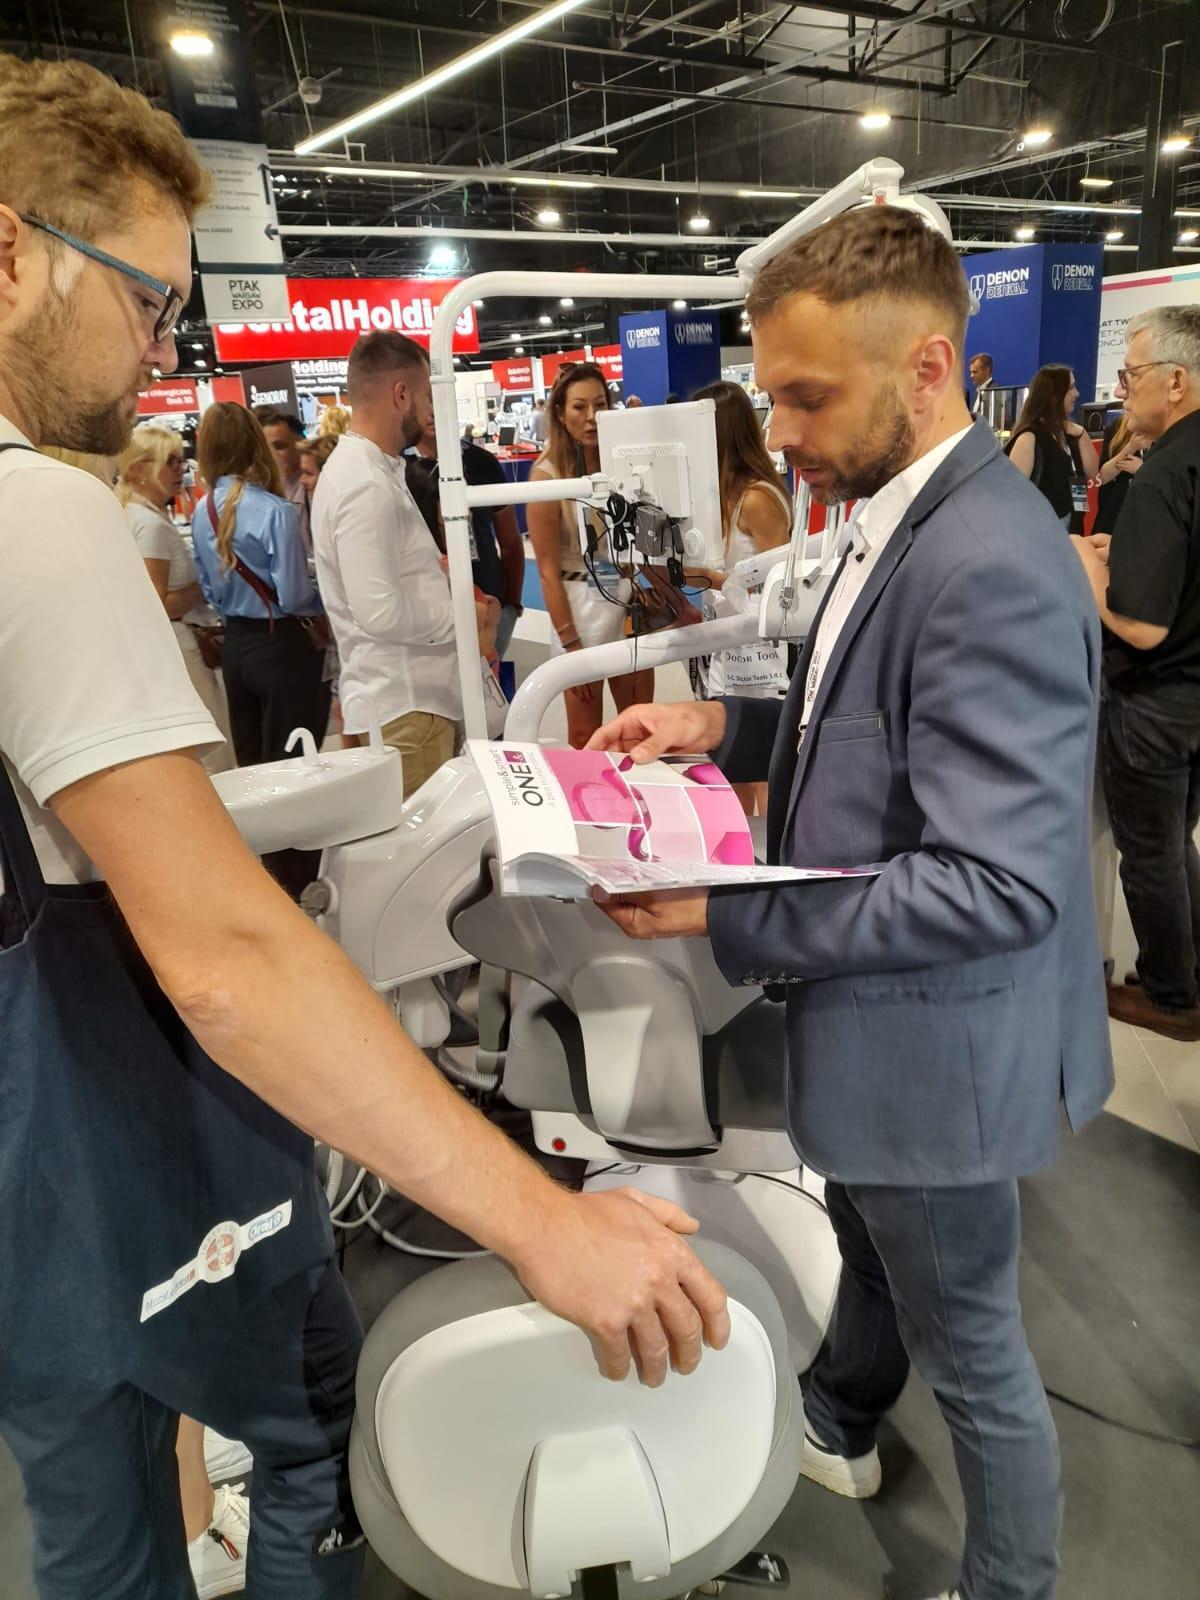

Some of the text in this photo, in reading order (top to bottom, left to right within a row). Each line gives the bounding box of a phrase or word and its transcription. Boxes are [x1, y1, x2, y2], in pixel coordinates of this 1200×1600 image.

[987, 267, 1030, 285] DENON
[1064, 265, 1095, 277] DENON
[228, 280, 260, 292] PTAK
[231, 291, 261, 299] WARSAW
[232, 299, 264, 311] EXPO
[217, 298, 475, 337] talHoldig
[1114, 316, 1130, 326] TW
[636, 326, 660, 338] DENON
[686, 323, 713, 335] DENON
[1100, 328, 1125, 338] ETYC
[509, 763, 544, 807] ONE
